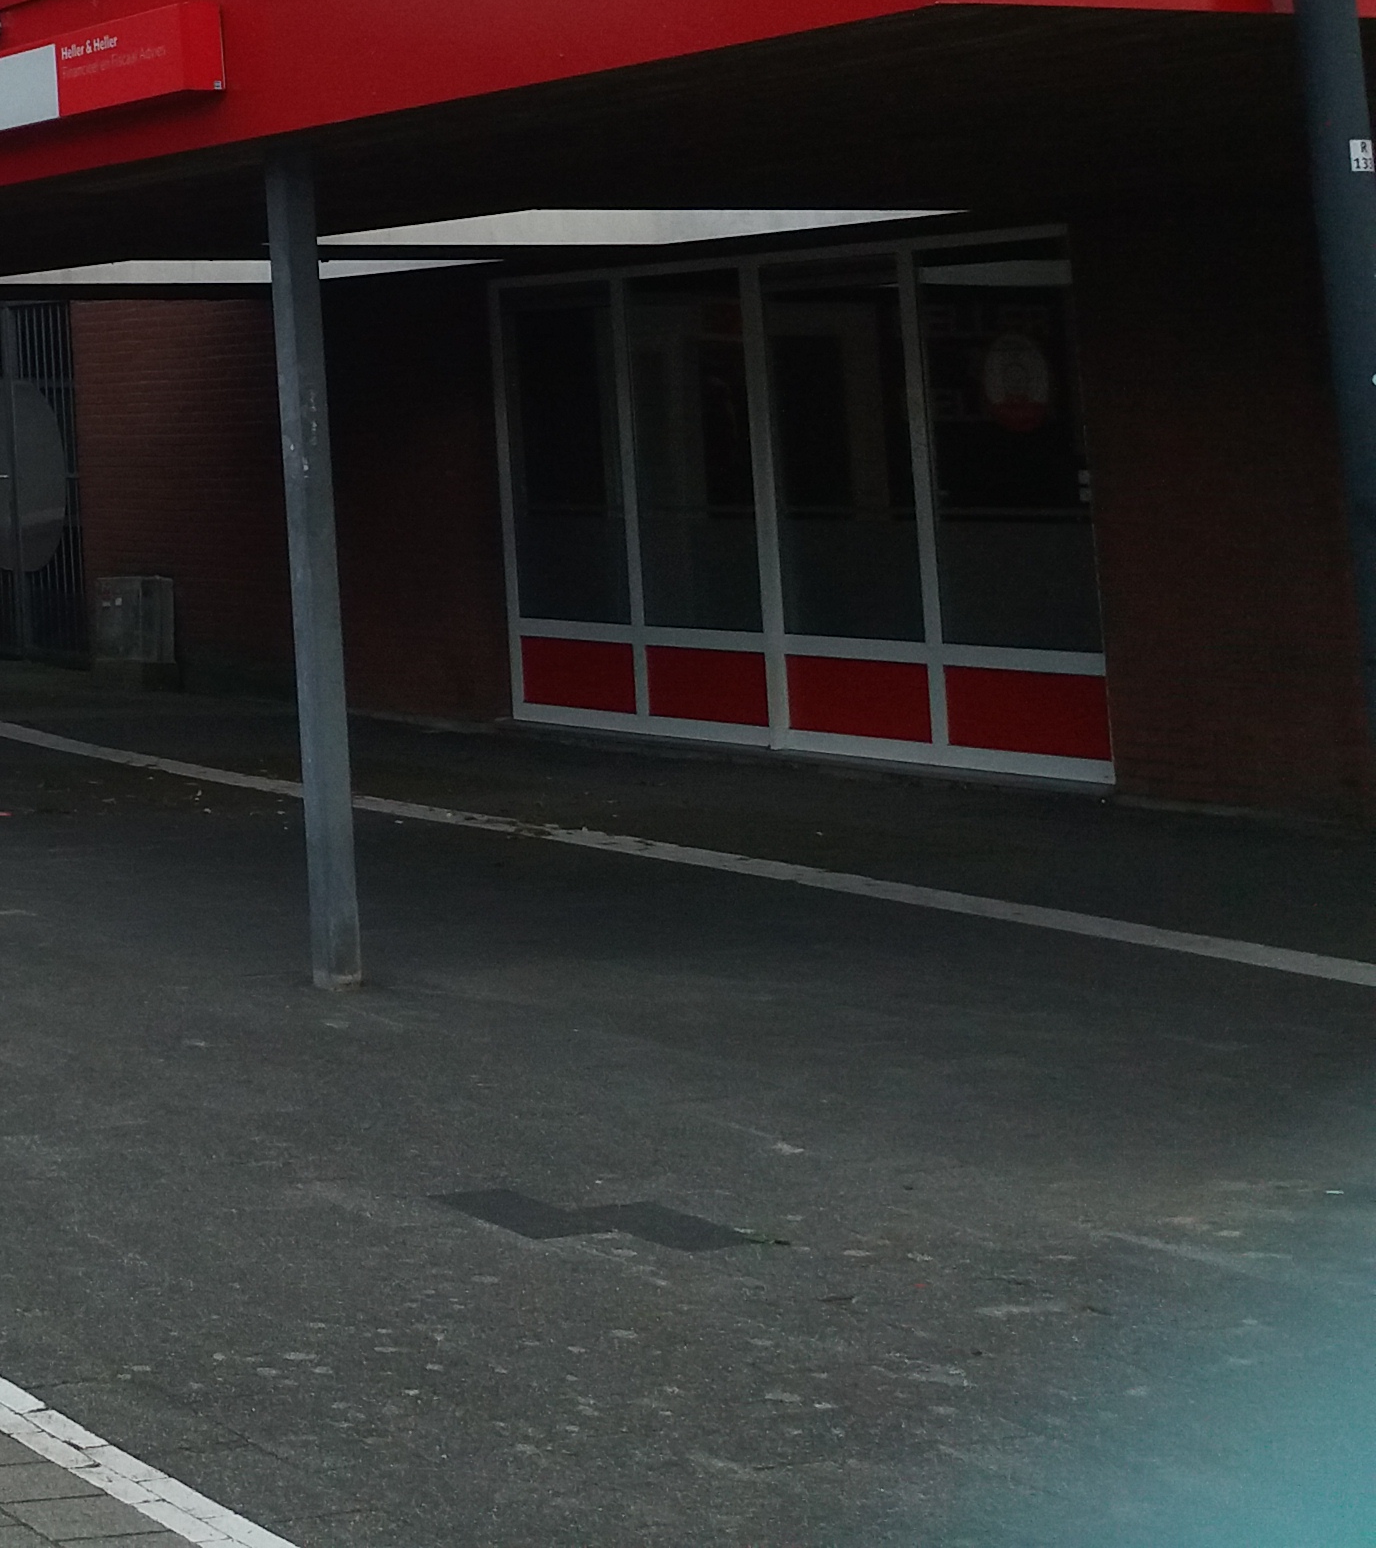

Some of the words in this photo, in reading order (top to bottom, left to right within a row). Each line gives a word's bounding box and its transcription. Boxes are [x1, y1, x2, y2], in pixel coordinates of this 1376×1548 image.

[61, 43, 84, 60] Heller
[85, 39, 93, 54] &
[93, 34, 118, 51] Heller
[1360, 141, 1368, 153] R
